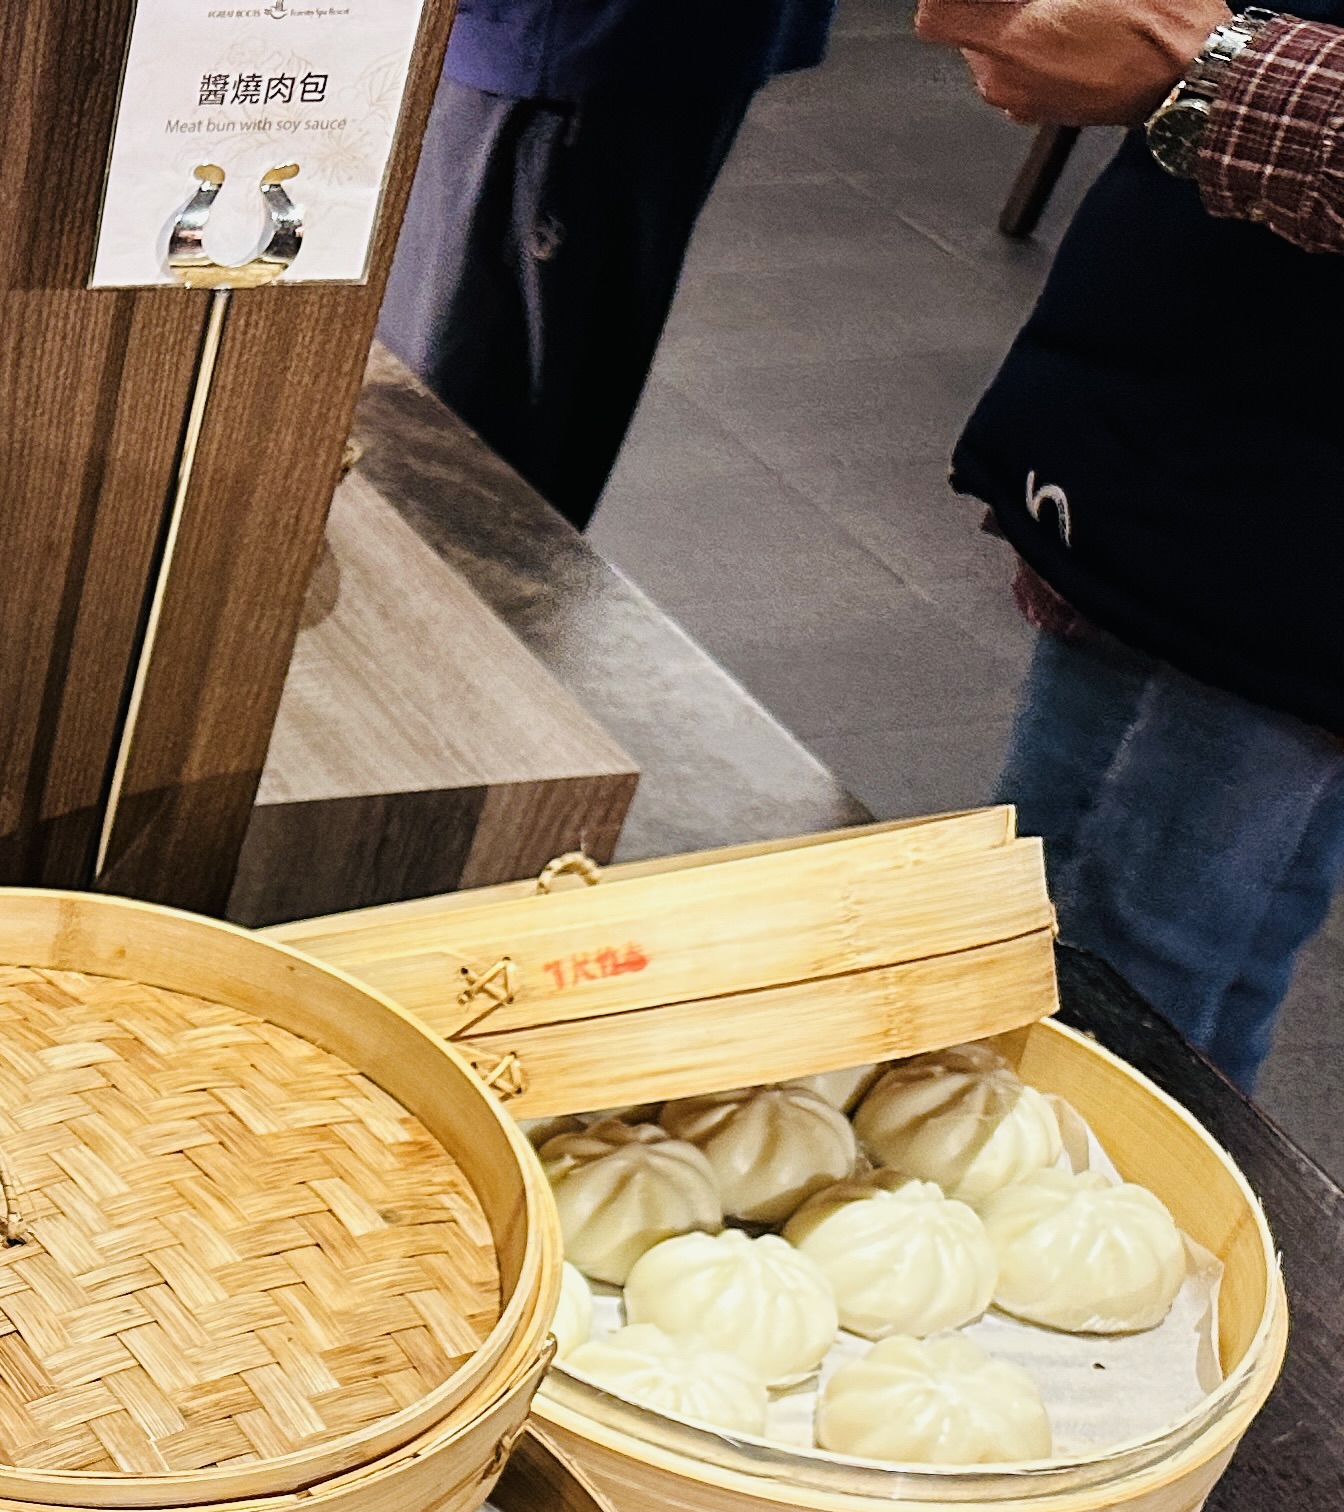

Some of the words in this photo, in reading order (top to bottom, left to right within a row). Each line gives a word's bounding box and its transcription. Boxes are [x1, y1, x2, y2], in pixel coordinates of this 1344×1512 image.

[198, 71, 329, 107] 醬燒肉包
[164, 119, 202, 134] Meat
[206, 117, 235, 132] bun
[240, 117, 272, 132] with
[275, 119, 301, 133] soy
[304, 117, 347, 130] sauce
